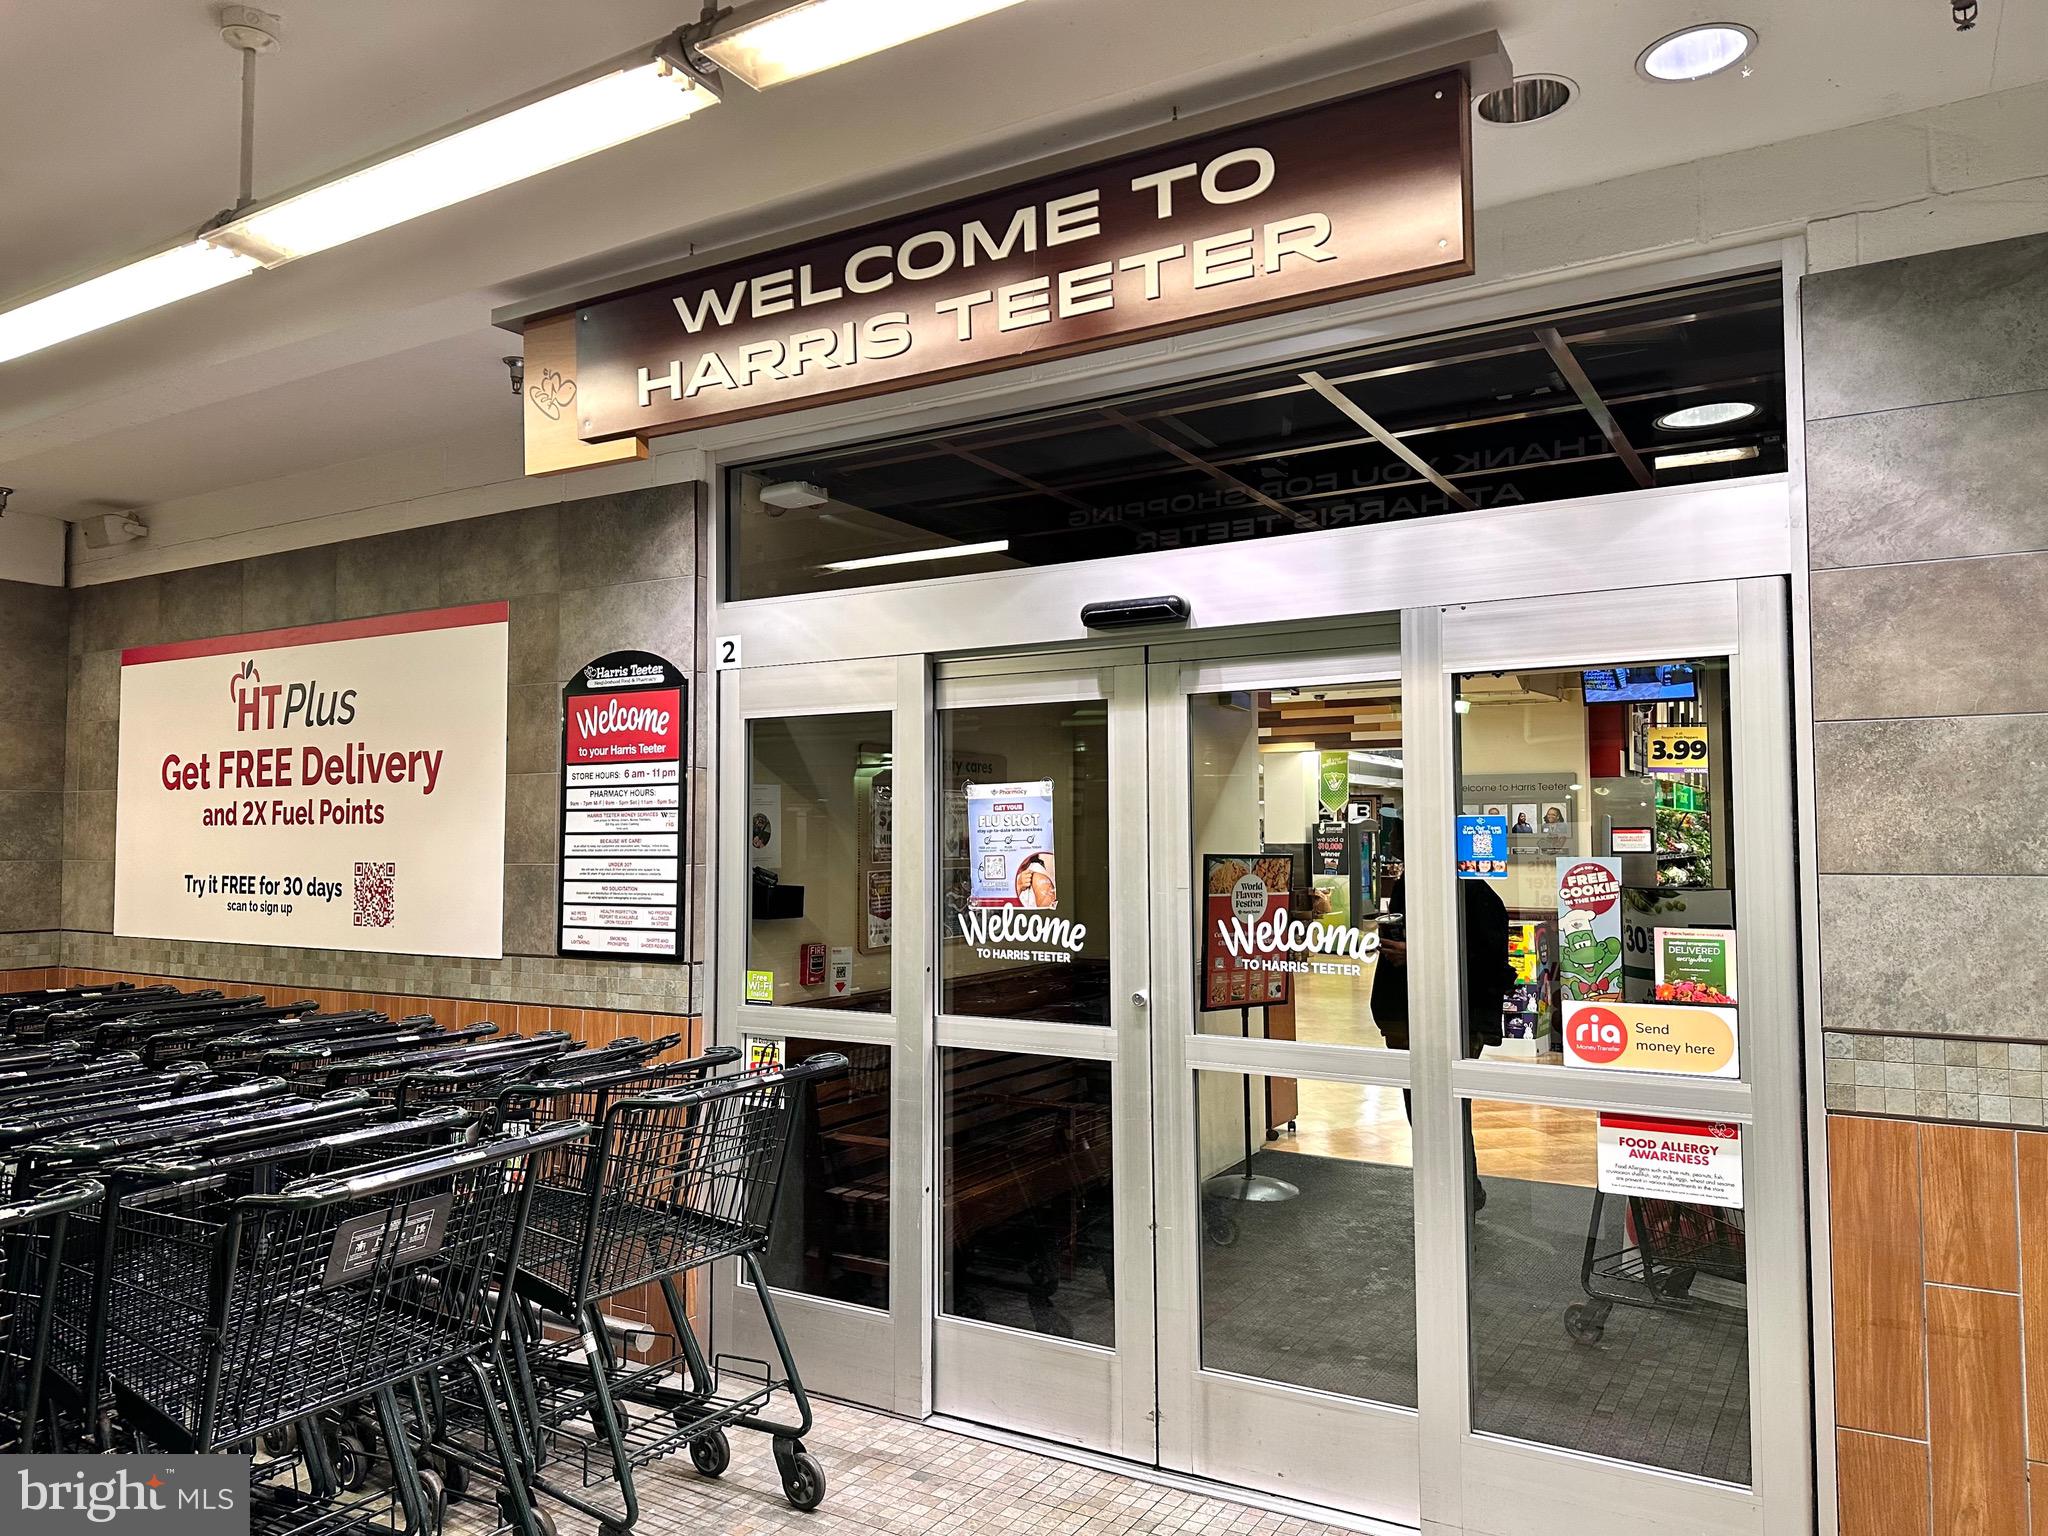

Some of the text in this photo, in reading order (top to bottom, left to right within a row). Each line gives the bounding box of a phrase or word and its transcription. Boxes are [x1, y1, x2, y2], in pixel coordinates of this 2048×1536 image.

[672, 147, 1276, 335] WELCOME TO
[637, 212, 1339, 407] HARRIS TEETER
[723, 641, 736, 663] 2
[596, 664, 664, 678] Harris Teeter
[576, 698, 670, 740] Welcome
[578, 743, 666, 759] to your Harris Teeter
[1652, 740, 1707, 760] 3.99
[161, 742, 443, 795] Get FREE Delivery
[624, 769, 630, 778] 6
[631, 770, 645, 778] am
[652, 768, 660, 778] 11
[662, 769, 676, 780] pm
[966, 763, 992, 774] cares
[590, 789, 628, 798] PHARMACY
[1500, 783, 1508, 792] to
[1511, 782, 1536, 791] Harris
[1538, 782, 1567, 791] Teeter
[202, 798, 385, 826] and 2X Fuel Points
[978, 813, 1040, 827] FLU SHOT
[1241, 882, 1263, 890] World
[1567, 872, 1608, 886] FREE
[185, 874, 343, 902] Try it FREE for 30 days
[1236, 891, 1263, 900] Flavors
[1559, 881, 1620, 899] COOKIE
[1236, 900, 1263, 908] Festival
[1590, 893, 1619, 903] BAKERY
[227, 900, 293, 917] scan to sign up
[958, 902, 1086, 952] Welcome
[1218, 908, 1380, 964] Welcome
[810, 946, 825, 954] FIRE
[977, 948, 1071, 963] TO HARRIS TEETER
[1668, 946, 1720, 955] DELIVERED
[1242, 959, 1360, 976] TO HARRIS TEETER
[752, 973, 768, 981] Free
[748, 982, 772, 990] Wi-Fi
[1575, 1014, 1620, 1044] ria
[1635, 1022, 1670, 1035] Send
[1636, 1042, 1715, 1055] money here
[1619, 1137, 1719, 1156] FOOD ALLERGY
[1629, 1149, 1710, 1166] AWARENESS
